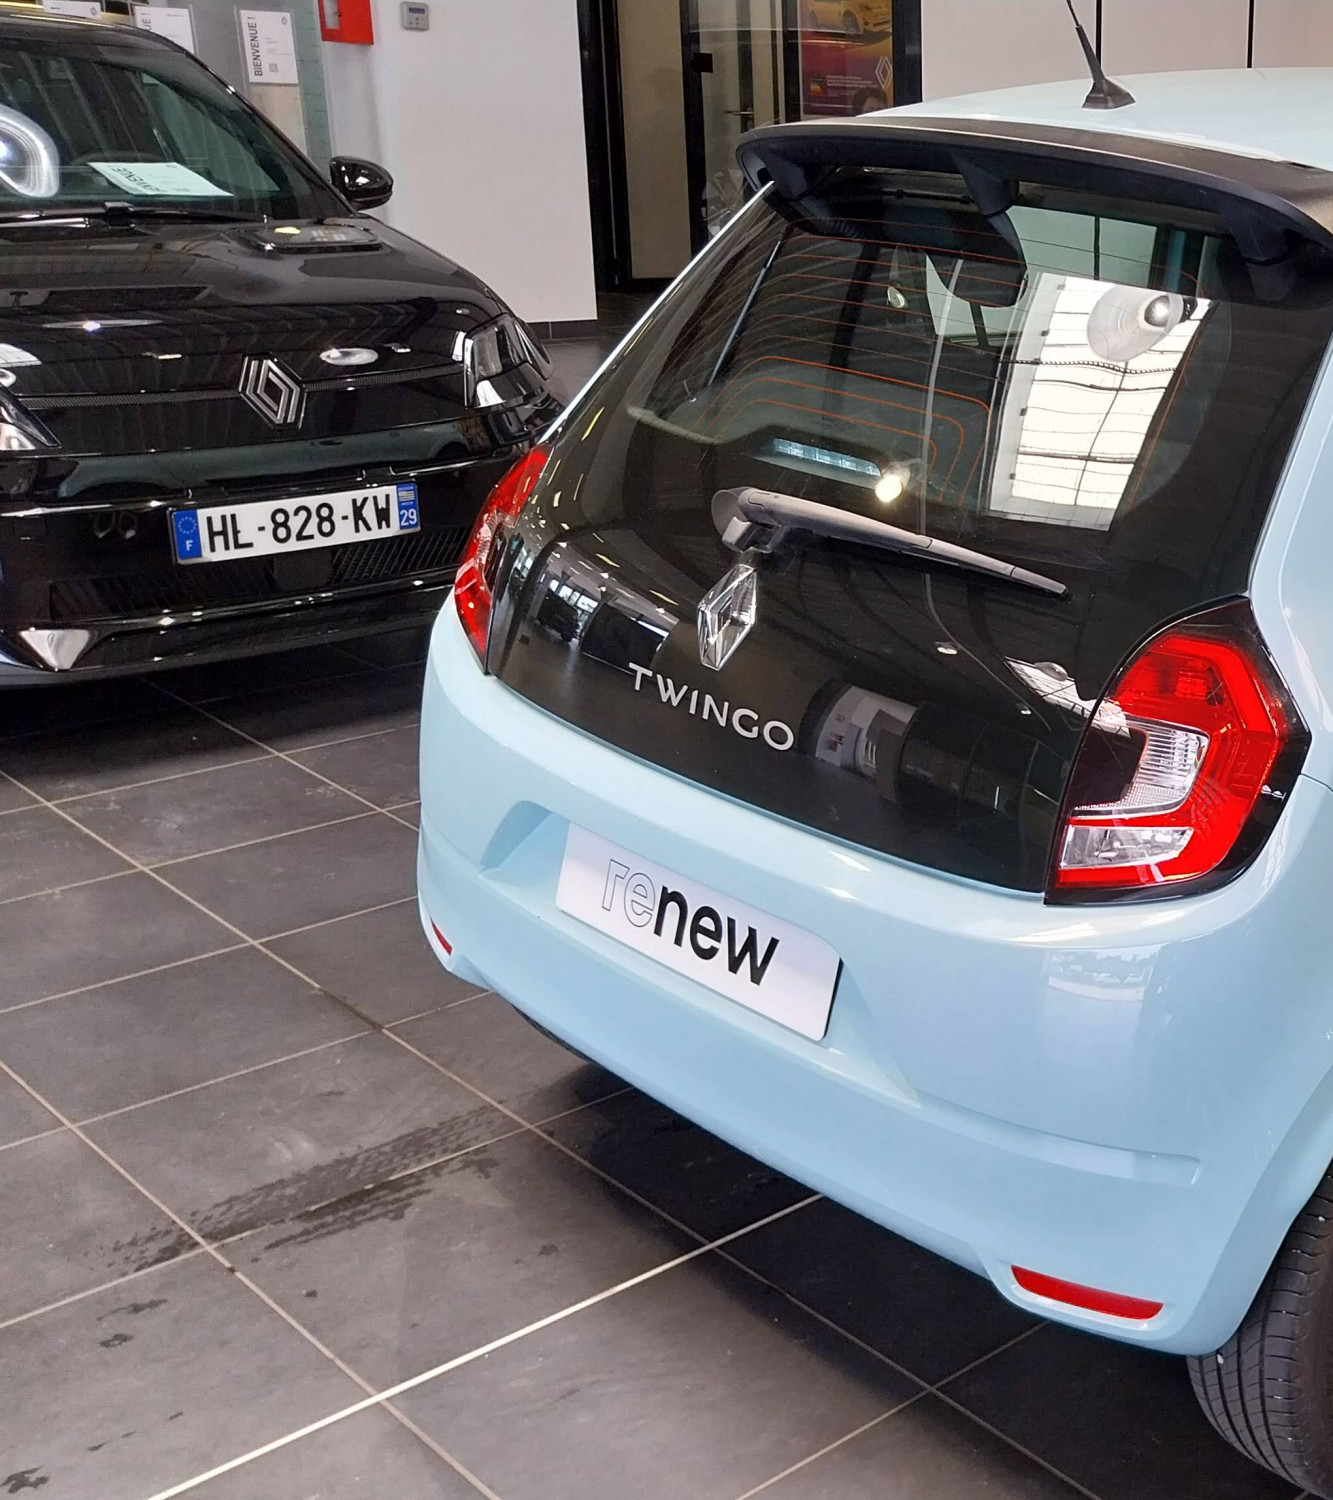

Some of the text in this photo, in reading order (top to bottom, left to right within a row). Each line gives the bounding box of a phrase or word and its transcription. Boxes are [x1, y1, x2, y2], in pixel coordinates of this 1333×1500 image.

[247, 22, 263, 76] BIENVENUE
[185, 540, 194, 552] F
[206, 493, 391, 553] HL-828-KW
[400, 508, 417, 527] 29
[628, 662, 794, 751] TWINGO
[602, 858, 780, 986] renew
